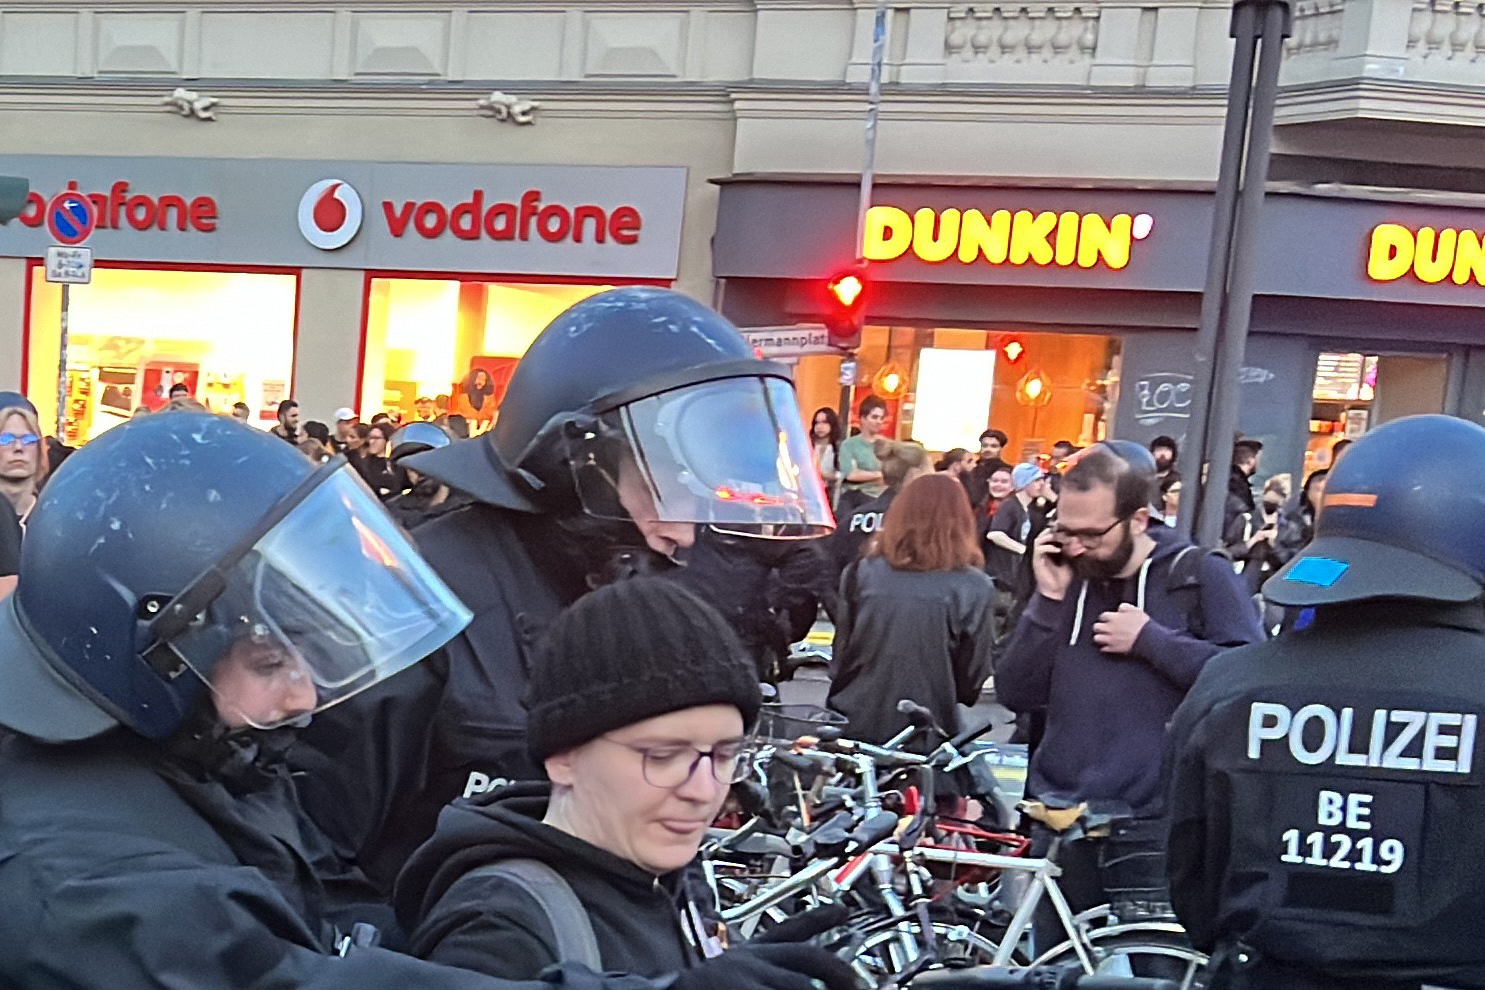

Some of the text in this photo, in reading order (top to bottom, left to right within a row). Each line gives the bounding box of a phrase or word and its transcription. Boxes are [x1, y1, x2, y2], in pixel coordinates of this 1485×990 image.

[18, 180, 219, 232] oafone
[381, 189, 642, 245] vodafone
[1246, 701, 1478, 774] POLIZEI
[1317, 790, 1374, 830] BE
[1280, 828, 1405, 874] 11219
